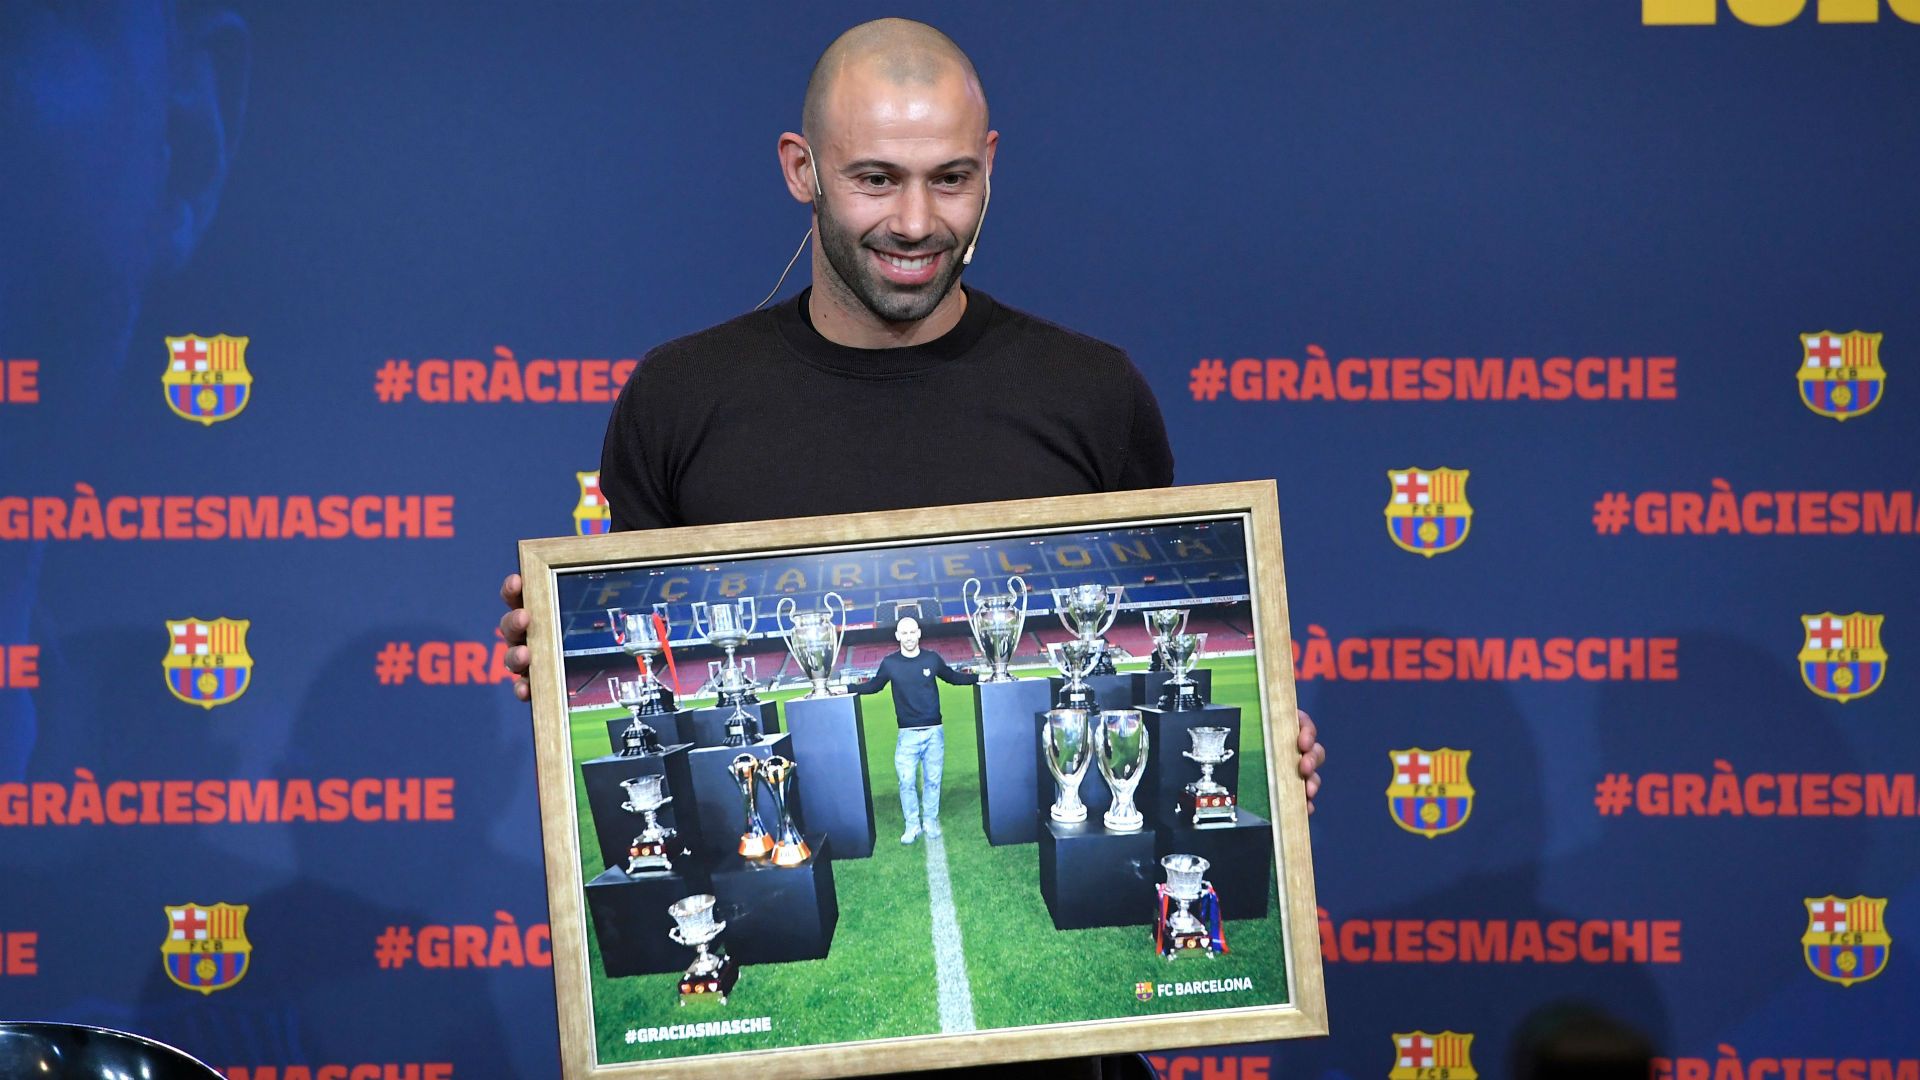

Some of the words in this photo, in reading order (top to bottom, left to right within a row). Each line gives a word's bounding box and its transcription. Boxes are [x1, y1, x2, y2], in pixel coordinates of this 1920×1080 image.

[0, 360, 39, 402] E
[1190, 345, 1677, 402] #GRÀCIESMASCHE
[1593, 478, 1920, 535] #GRÀCIESM
[0, 645, 39, 688] E
[1594, 759, 1920, 816] #GRÀCIESM
[0, 932, 38, 975] E
[1157, 983, 1174, 998] FC
[1175, 976, 1253, 996] BARCELONA
[624, 1016, 773, 1045] #GRACIASMASCHE
